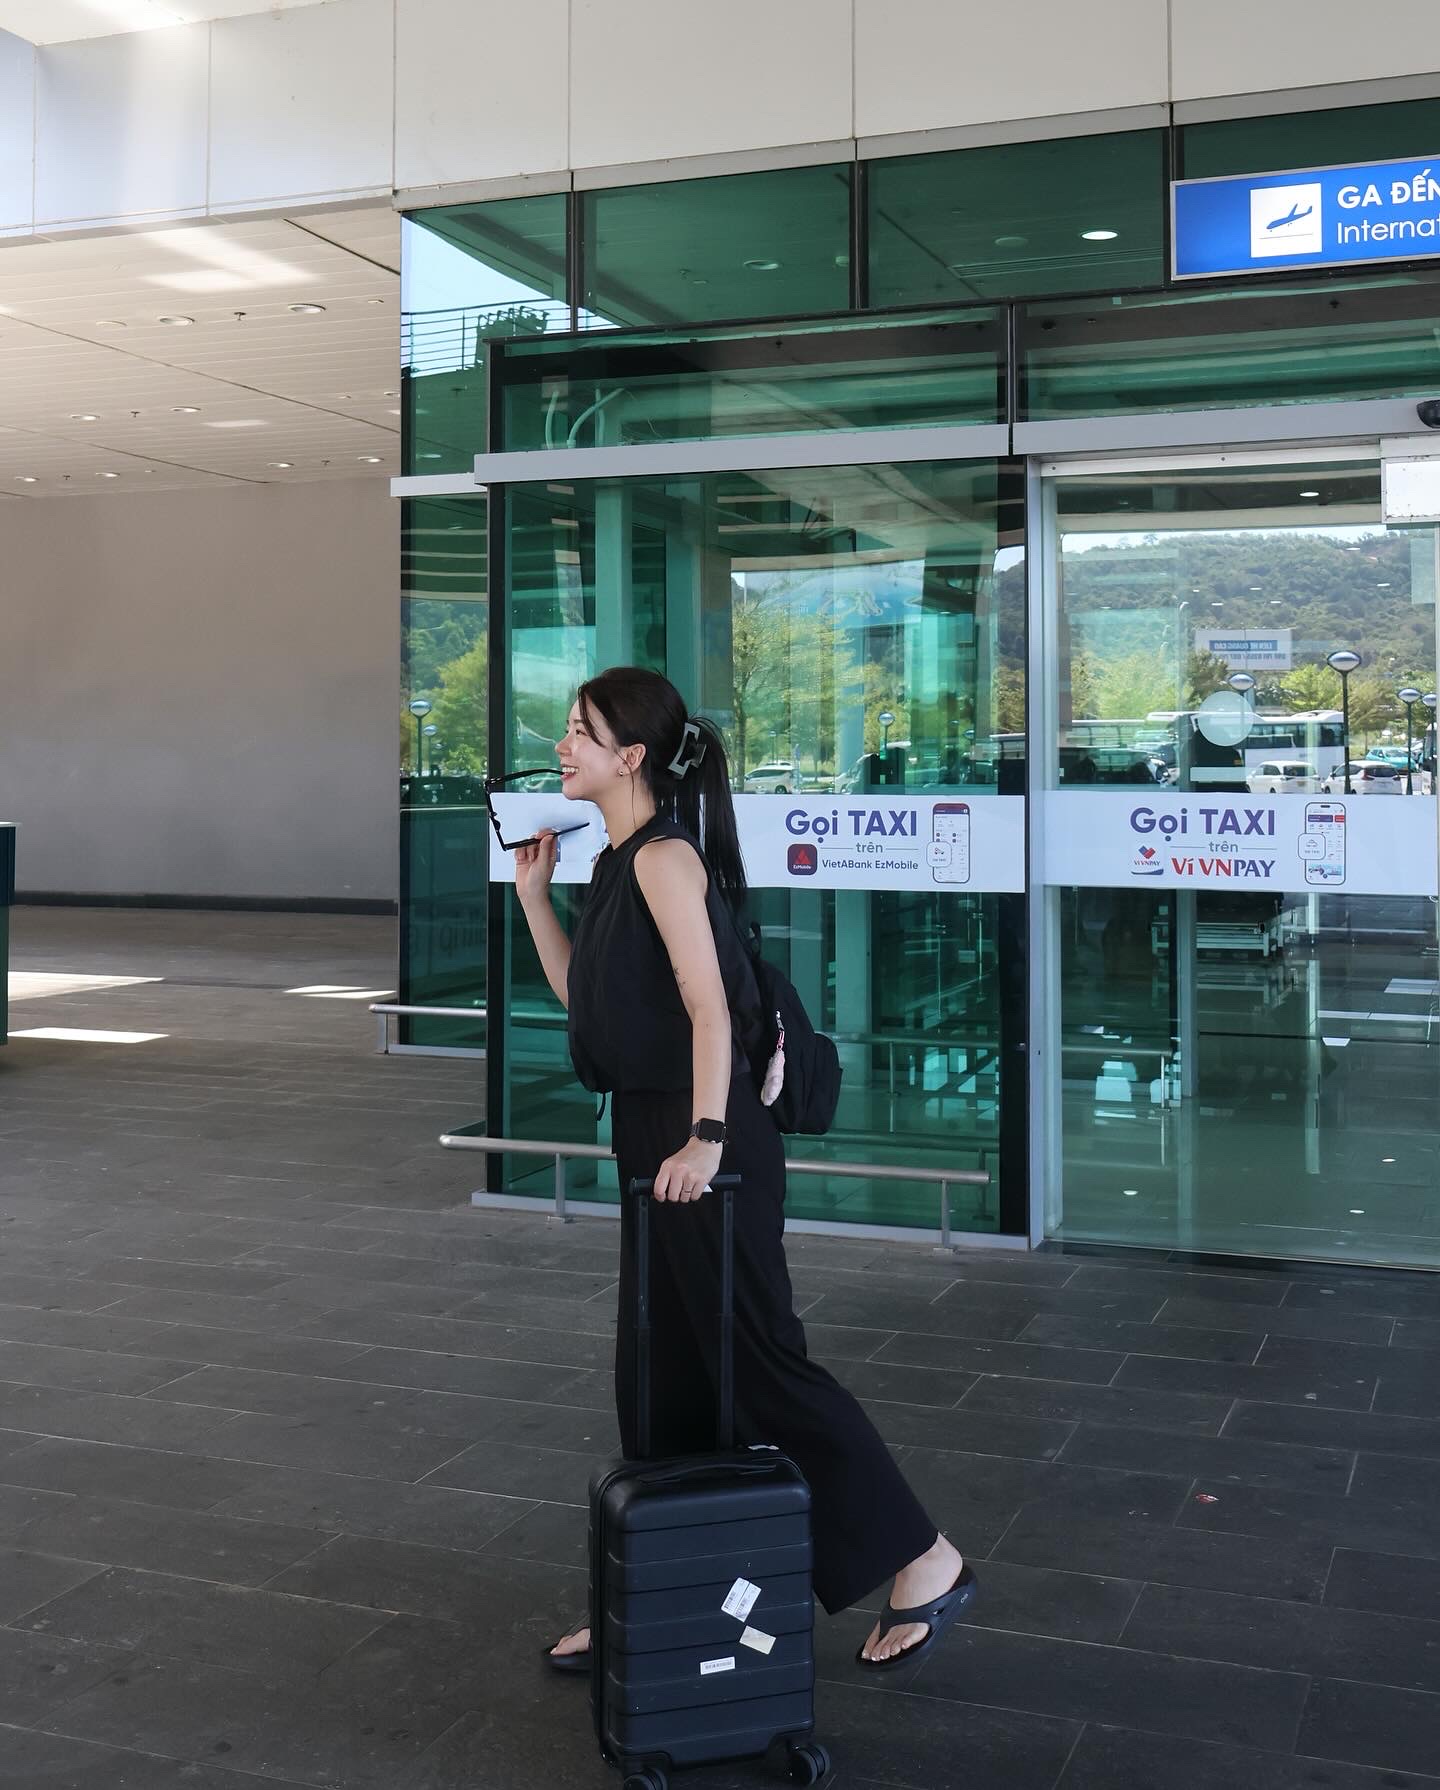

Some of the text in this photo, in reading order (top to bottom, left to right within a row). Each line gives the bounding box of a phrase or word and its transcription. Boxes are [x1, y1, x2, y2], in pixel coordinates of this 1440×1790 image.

[1337, 184, 1383, 209] GA
[1337, 213, 1440, 244] Interna
[785, 809, 917, 843] Gọi TAXI
[1130, 807, 1275, 841] Gọi TAXI
[856, 841, 883, 853] trên
[1208, 840, 1239, 852] trên
[822, 859, 919, 870] VietABank EzMobile
[1171, 857, 1276, 877] Ví VNPAY
